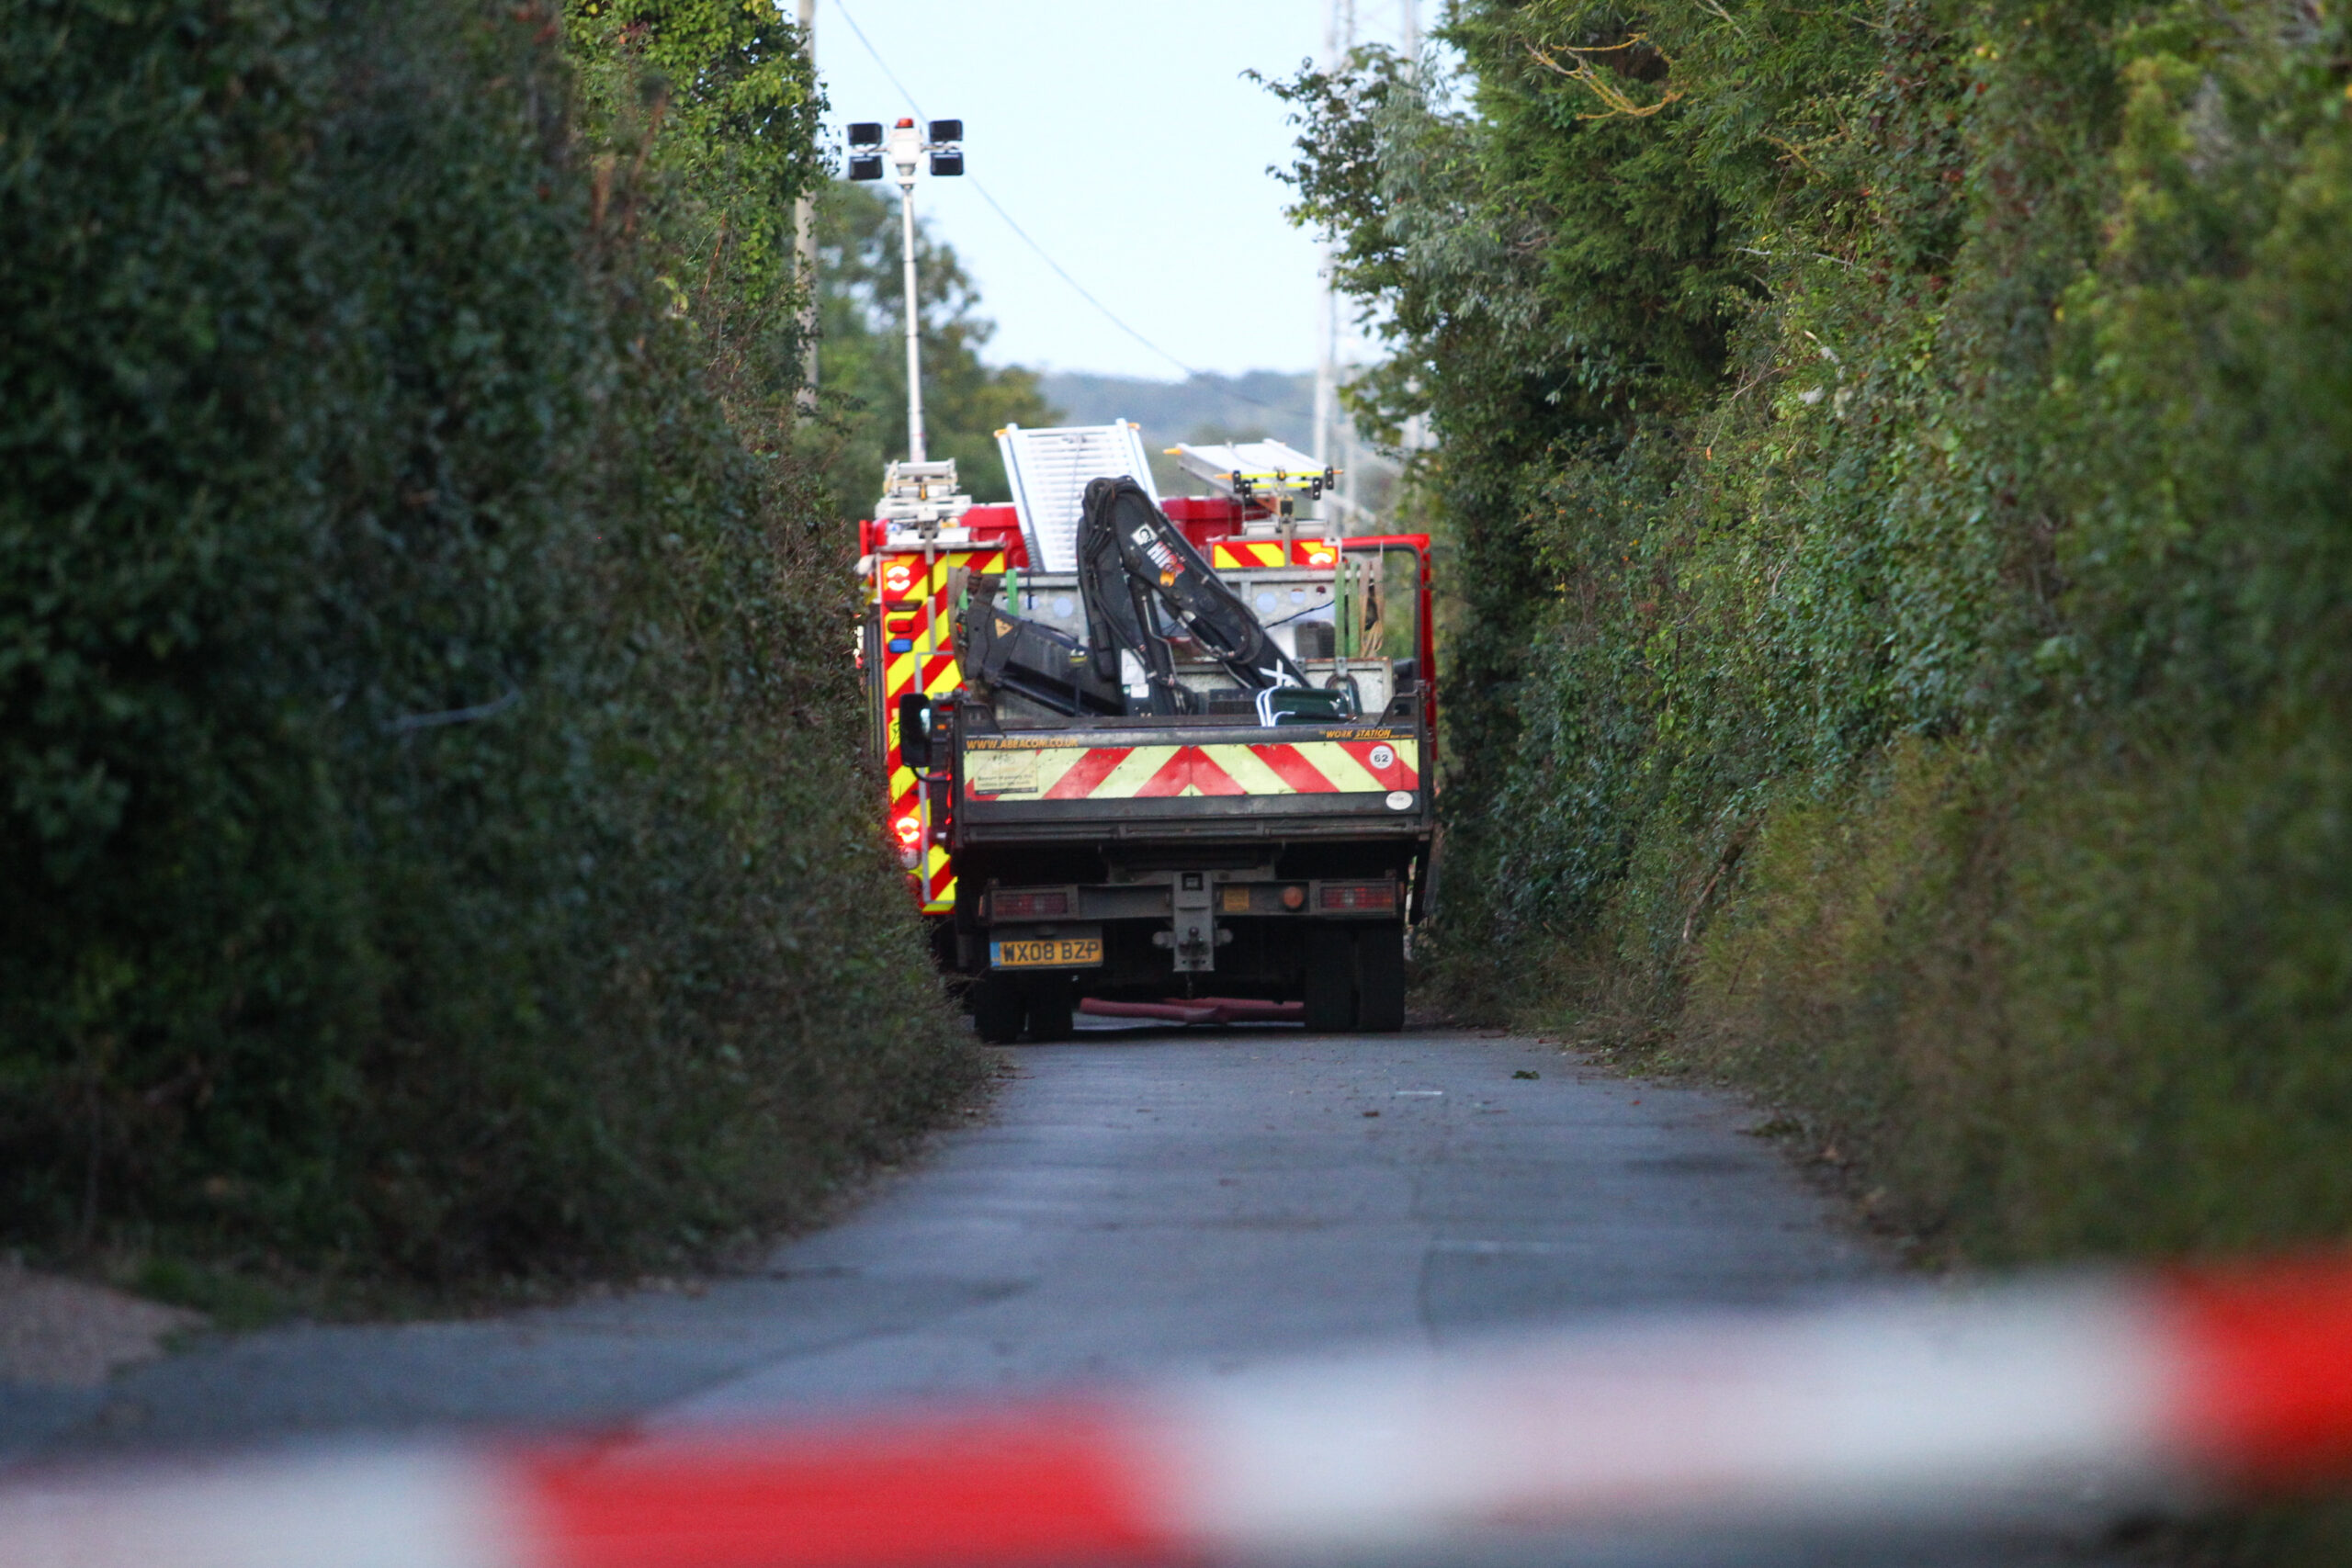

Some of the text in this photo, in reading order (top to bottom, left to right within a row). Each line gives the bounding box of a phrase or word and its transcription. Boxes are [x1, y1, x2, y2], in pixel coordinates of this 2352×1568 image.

[1326, 729, 1352, 739] WORK
[1355, 728, 1392, 739] STATION
[1374, 754, 1389, 762] 62
[1003, 941, 1100, 962] WX08 BZP
